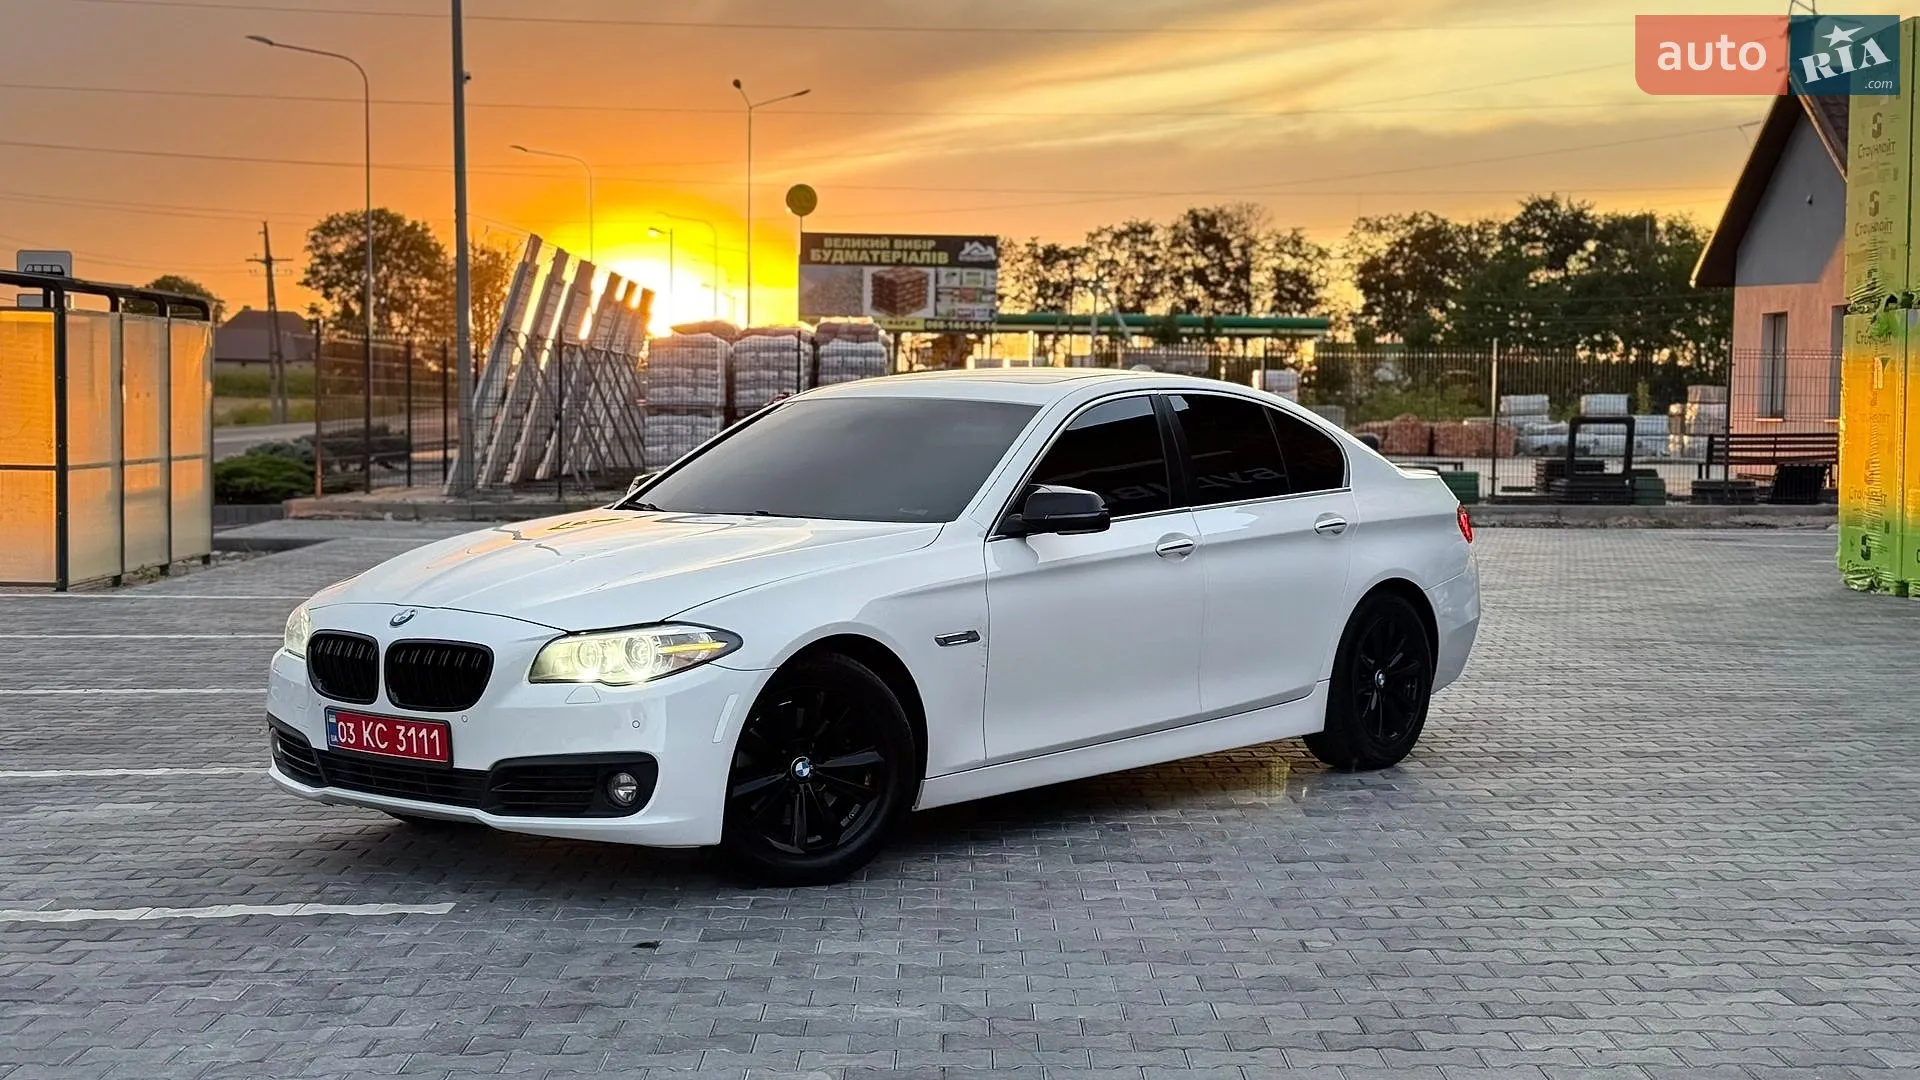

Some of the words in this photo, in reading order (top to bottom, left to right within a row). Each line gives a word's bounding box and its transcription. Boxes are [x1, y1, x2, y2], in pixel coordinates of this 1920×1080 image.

[823, 237, 892, 249] ВЕЛИКИЙ
[893, 239, 936, 250] ВИБІР
[810, 249, 949, 264] БУДМАТЕРІАЛІВ
[337, 721, 356, 744] 03
[362, 720, 389, 749] KC
[396, 725, 440, 756] 3111
